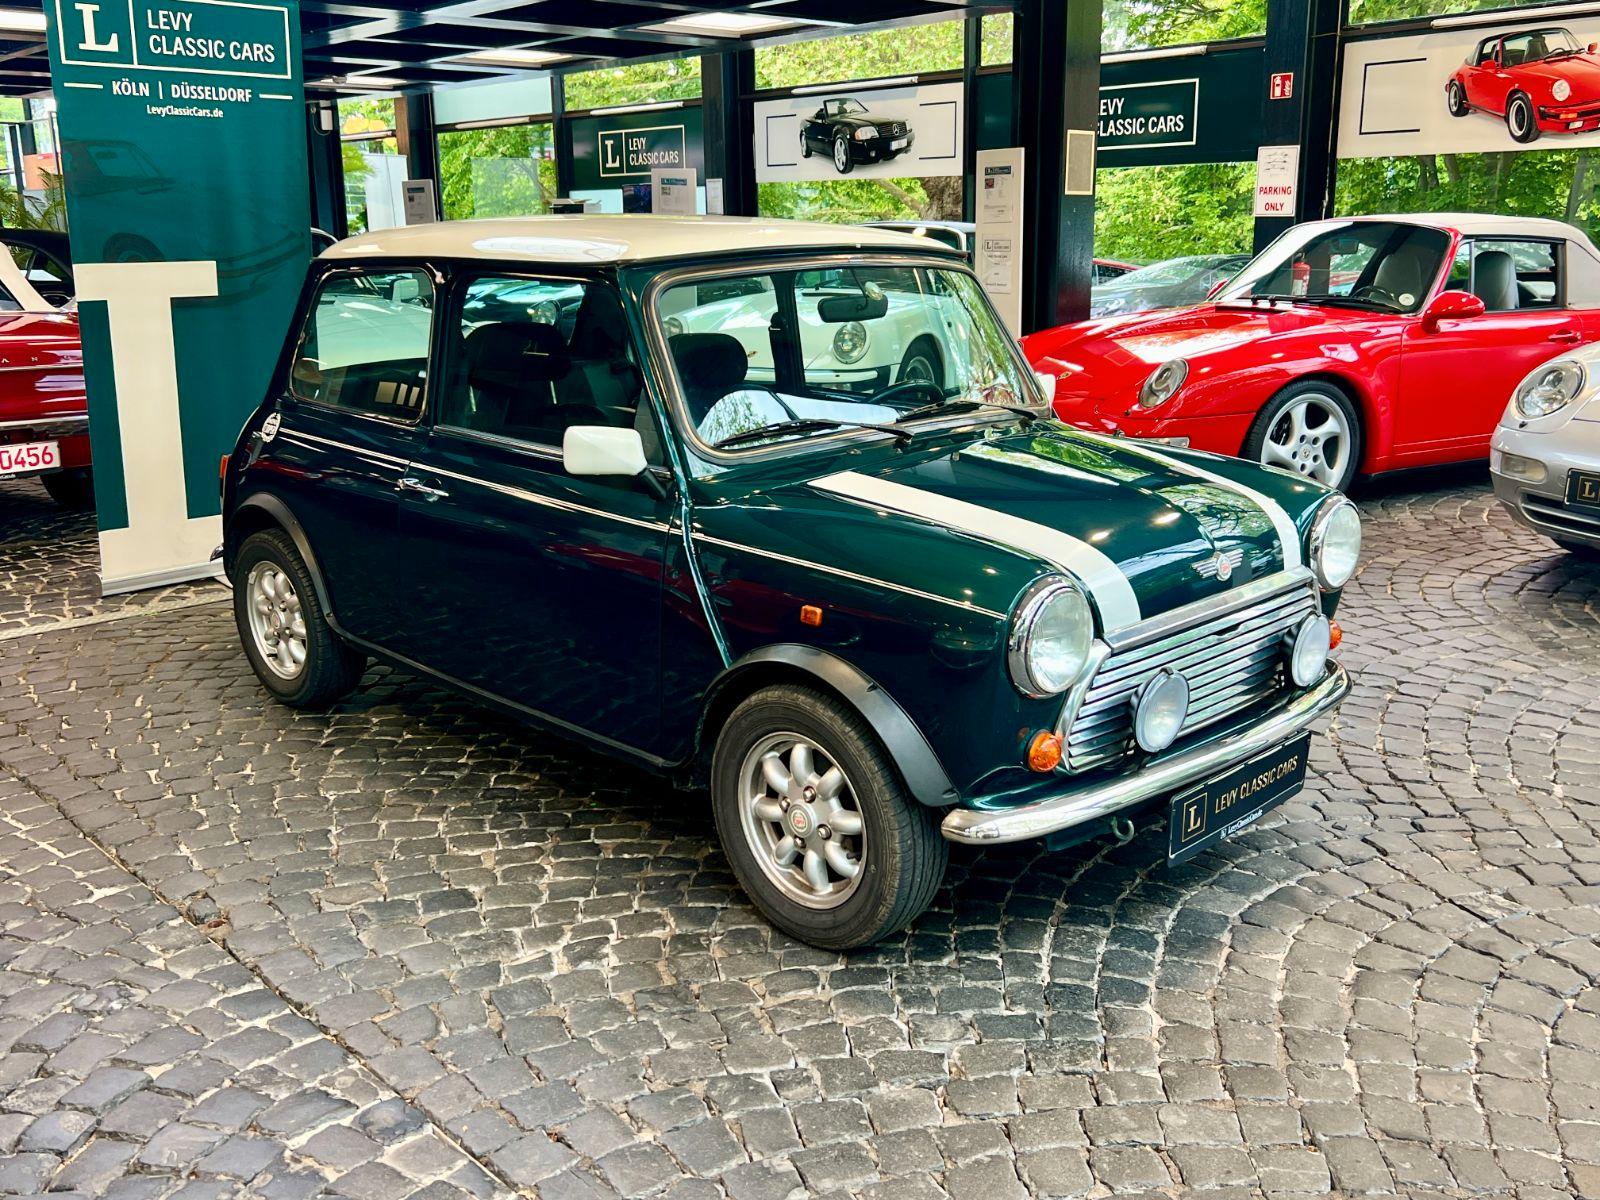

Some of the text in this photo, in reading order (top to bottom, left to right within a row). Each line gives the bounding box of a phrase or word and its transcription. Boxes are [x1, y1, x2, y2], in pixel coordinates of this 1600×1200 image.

[74, 3, 119, 53] L
[147, 9, 193, 31] LEVY
[149, 34, 275, 63] CLASSIC CARS
[112, 78, 252, 103] KÖLN DÜSSELDORF
[146, 104, 224, 118] LevyClassicCars.de
[1098, 97, 1125, 116] EVY
[1097, 114, 1184, 137] LASSIC CARS
[605, 140, 620, 168] L
[628, 137, 647, 151] LEVY
[629, 151, 679, 166] CLASSIC CARS
[1259, 185, 1292, 196] PARKING
[1264, 202, 1285, 212] ONLY
[1583, 481, 1596, 498] L
[1215, 755, 1298, 814] LEVY CLASSIC CARS
[1187, 804, 1201, 833] L
